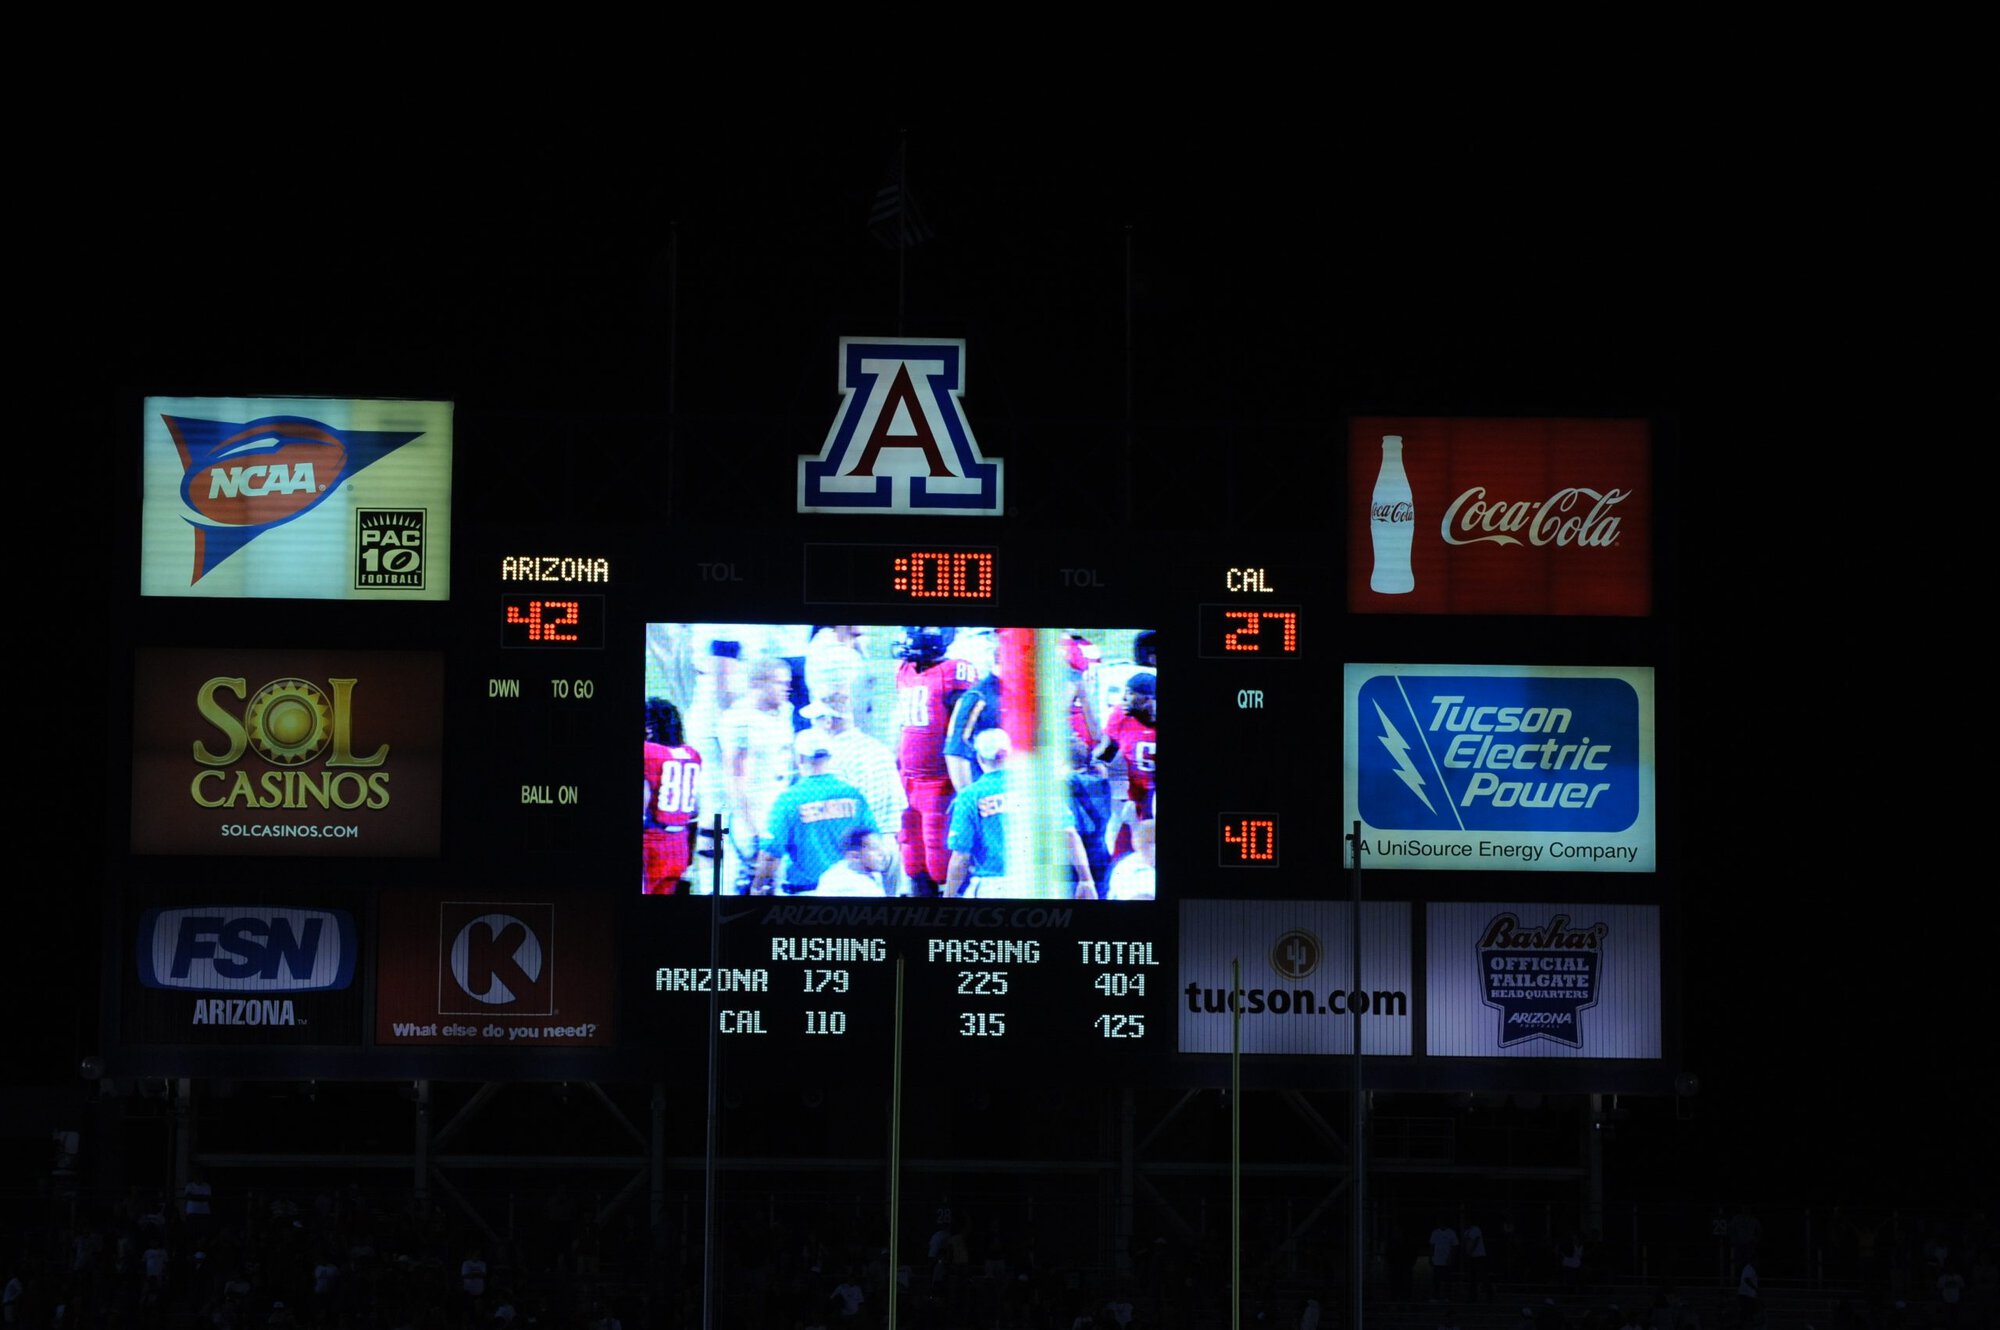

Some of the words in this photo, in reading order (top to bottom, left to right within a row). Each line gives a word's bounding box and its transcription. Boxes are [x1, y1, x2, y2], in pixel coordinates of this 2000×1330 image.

[208, 463, 316, 499] NCAA
[1441, 486, 1633, 547] Coca-Cola
[361, 530, 421, 546] PAC
[362, 549, 420, 573] 10
[502, 556, 609, 583] ARIZONA
[698, 563, 742, 582] TOL
[361, 574, 419, 584] FOOTBALL
[1060, 569, 1104, 587] TOL
[1226, 568, 1274, 593] CAL
[507, 601, 578, 641] 42
[1225, 611, 1296, 651] 27
[489, 680, 520, 698] DWN
[551, 681, 569, 698] TO
[574, 681, 594, 699] GO
[1237, 689, 1264, 709] QTR
[193, 676, 390, 767] SOL
[1429, 695, 1573, 733] Tucson
[1443, 734, 1612, 771] Electric
[190, 769, 391, 810] CASINOS
[521, 786, 553, 804] BALL
[558, 786, 578, 804] ON
[1460, 772, 1611, 809] Power
[220, 824, 359, 838] SOLCASINOS.COM
[1224, 820, 1274, 860] 40
[1377, 840, 1473, 856] UniSource
[1479, 841, 1544, 861] Energy
[1549, 842, 1638, 863] Company
[760, 905, 1073, 928] ARIZONAATHLETICS.COM
[170, 917, 324, 979] FSN
[771, 937, 887, 962] RUSHING
[928, 938, 1041, 964] PASSING
[1078, 940, 1160, 966] TOTAL
[1489, 956, 1590, 972] OFFICIAL
[802, 969, 850, 993] 179
[956, 971, 1009, 996] 225
[1093, 972, 1146, 997] 404
[1489, 973, 1590, 988] TAILGATE
[1184, 981, 1408, 1016] tucson.com
[1489, 989, 1589, 1000] HEADQUARTERS
[191, 998, 296, 1026] ARIZONA
[719, 1009, 768, 1034] CAL
[804, 1010, 848, 1035] 110
[959, 1011, 1006, 1037] 315
[1507, 1012, 1573, 1025] ARIZONA
[392, 1023, 438, 1037] What
[441, 1023, 478, 1038] else
[482, 1023, 505, 1038] do
[508, 1026, 541, 1041] you
[543, 1023, 596, 1039] need?
